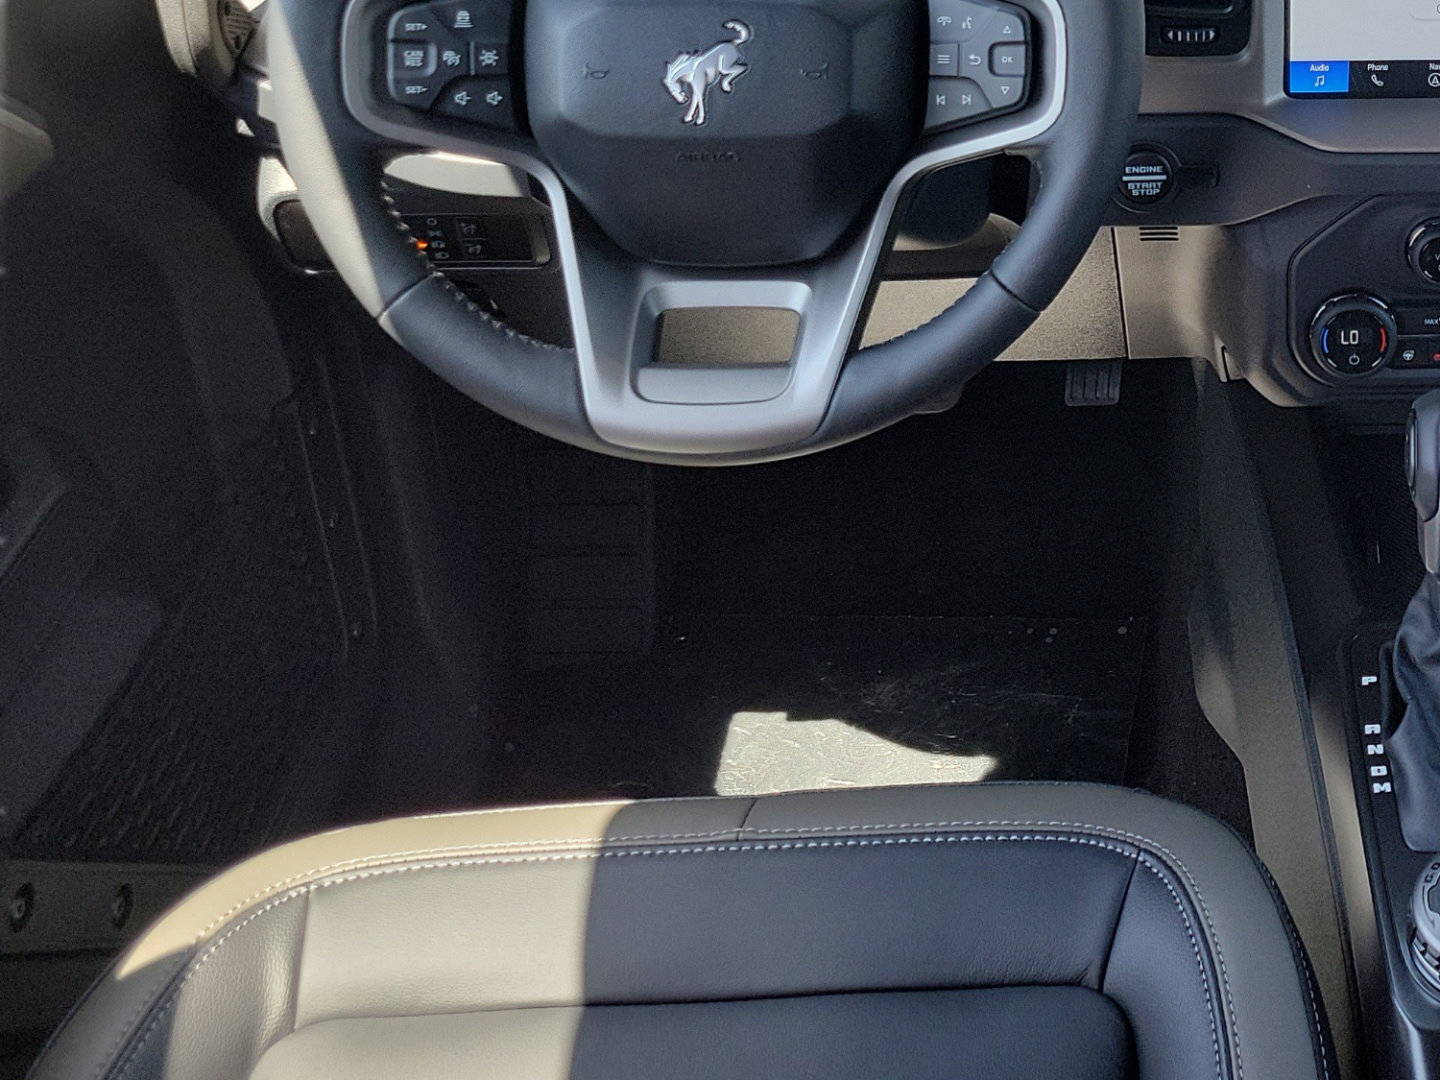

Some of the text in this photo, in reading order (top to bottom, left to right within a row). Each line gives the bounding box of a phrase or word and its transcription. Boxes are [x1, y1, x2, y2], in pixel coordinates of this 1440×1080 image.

[1002, 56, 1013, 64] OK
[1310, 64, 1330, 72] Audio
[1367, 63, 1388, 71] Phone
[1125, 166, 1163, 174] ENGINE
[1128, 182, 1162, 190] START
[1132, 188, 1160, 196] STOP
[1340, 330, 1359, 345] LO
[1362, 676, 1378, 686] P
[1368, 744, 1384, 754] N
[1370, 766, 1388, 776] D
[1373, 782, 1392, 793] M
